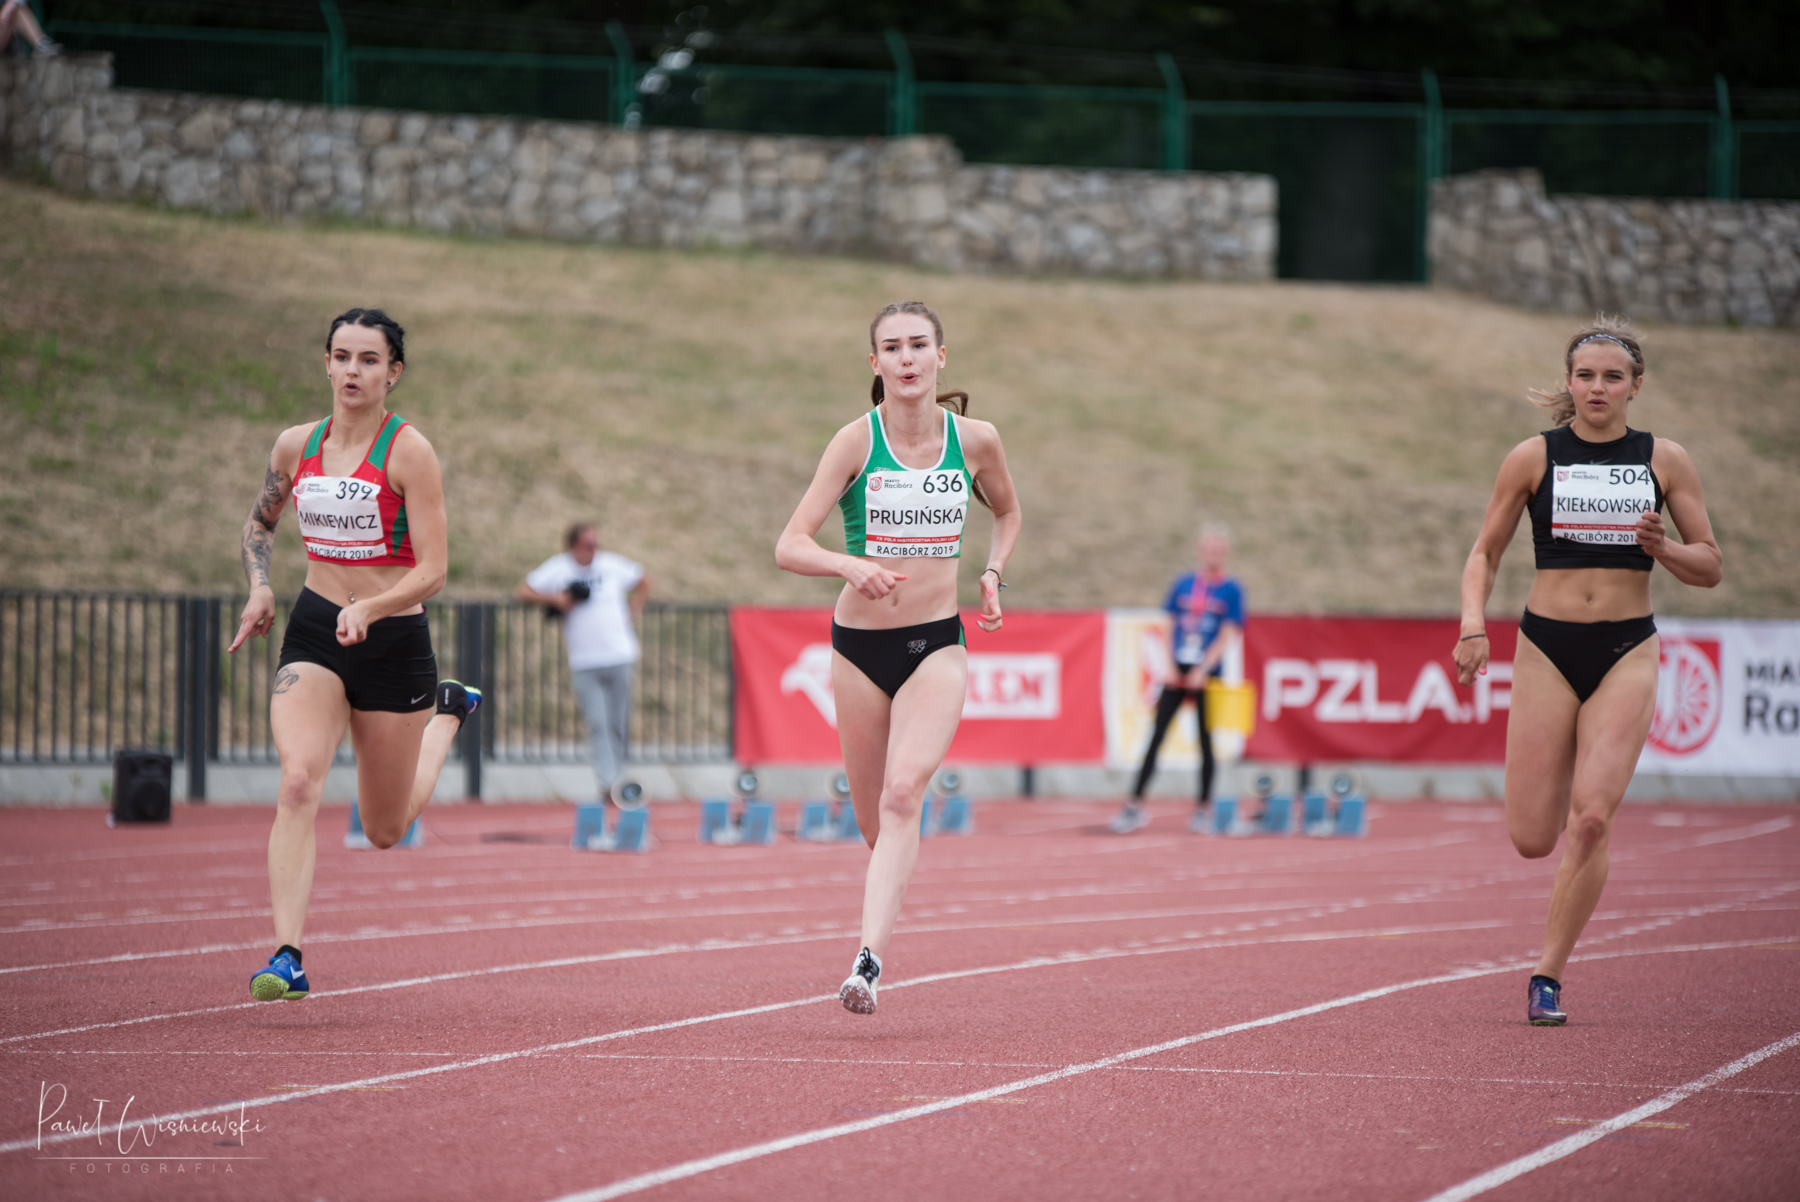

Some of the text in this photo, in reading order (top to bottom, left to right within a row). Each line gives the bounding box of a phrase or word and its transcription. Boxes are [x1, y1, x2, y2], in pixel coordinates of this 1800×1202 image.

[923, 473, 963, 494] 636
[1609, 468, 1650, 485] 504
[335, 481, 373, 500] 399
[1556, 497, 1651, 513] KIEŁKOWSKA
[299, 510, 378, 529] MIKIEWICZ
[870, 506, 963, 525] PRUSIŃSKA
[1563, 531, 1634, 542] RACIBÓRZ 201
[349, 549, 373, 559] 2019
[876, 545, 954, 556] RACIBÓRZ 2019
[1745, 662, 1800, 680] MIA
